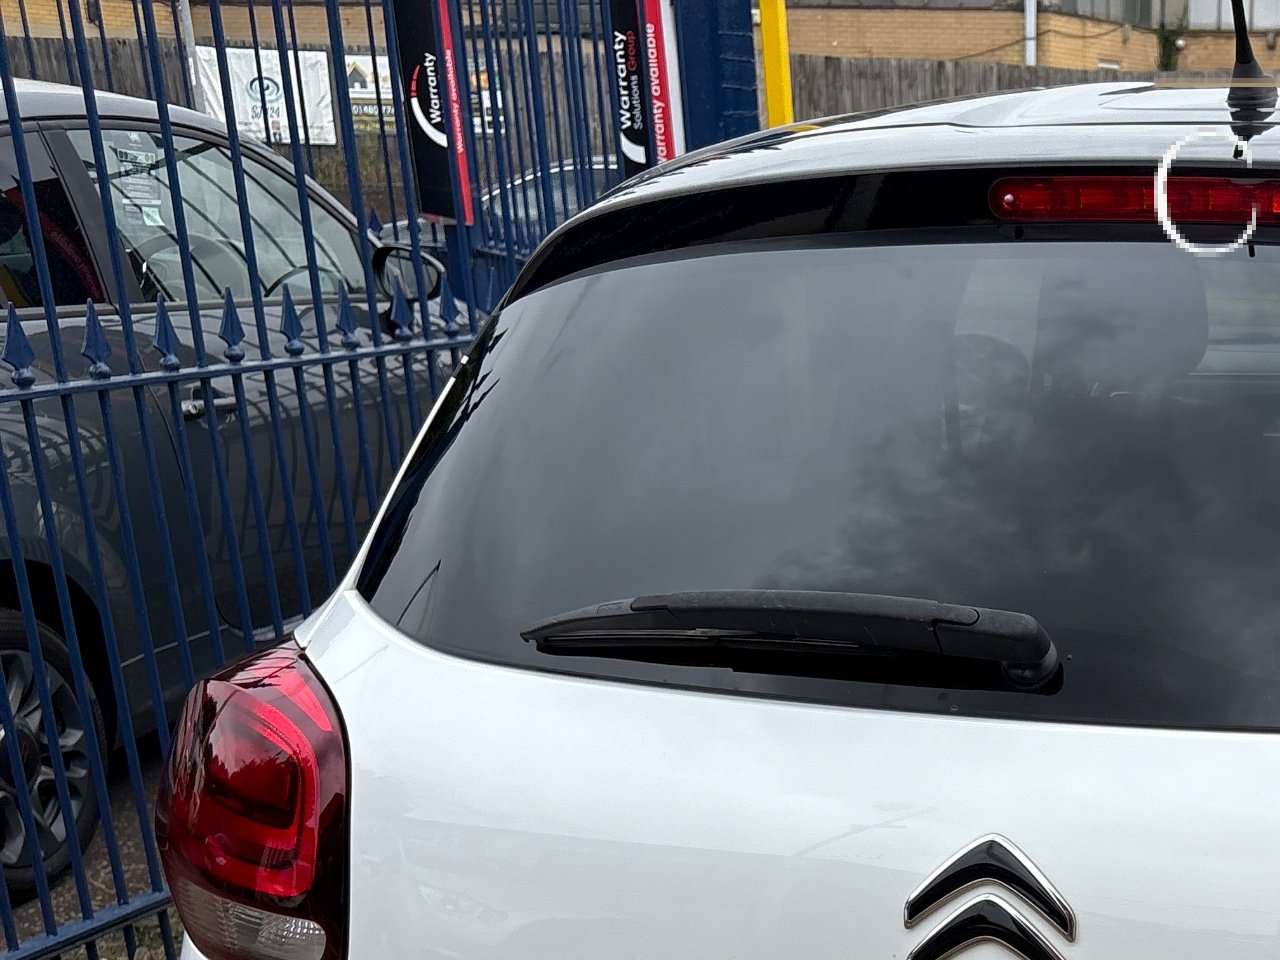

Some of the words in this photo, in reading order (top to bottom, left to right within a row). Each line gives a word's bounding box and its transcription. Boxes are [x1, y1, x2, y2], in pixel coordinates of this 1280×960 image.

[613, 30, 632, 130] Warranty
[626, 30, 638, 72] Group
[645, 23, 661, 96] available
[424, 52, 442, 124] Warranty
[629, 74, 643, 130] Solutions
